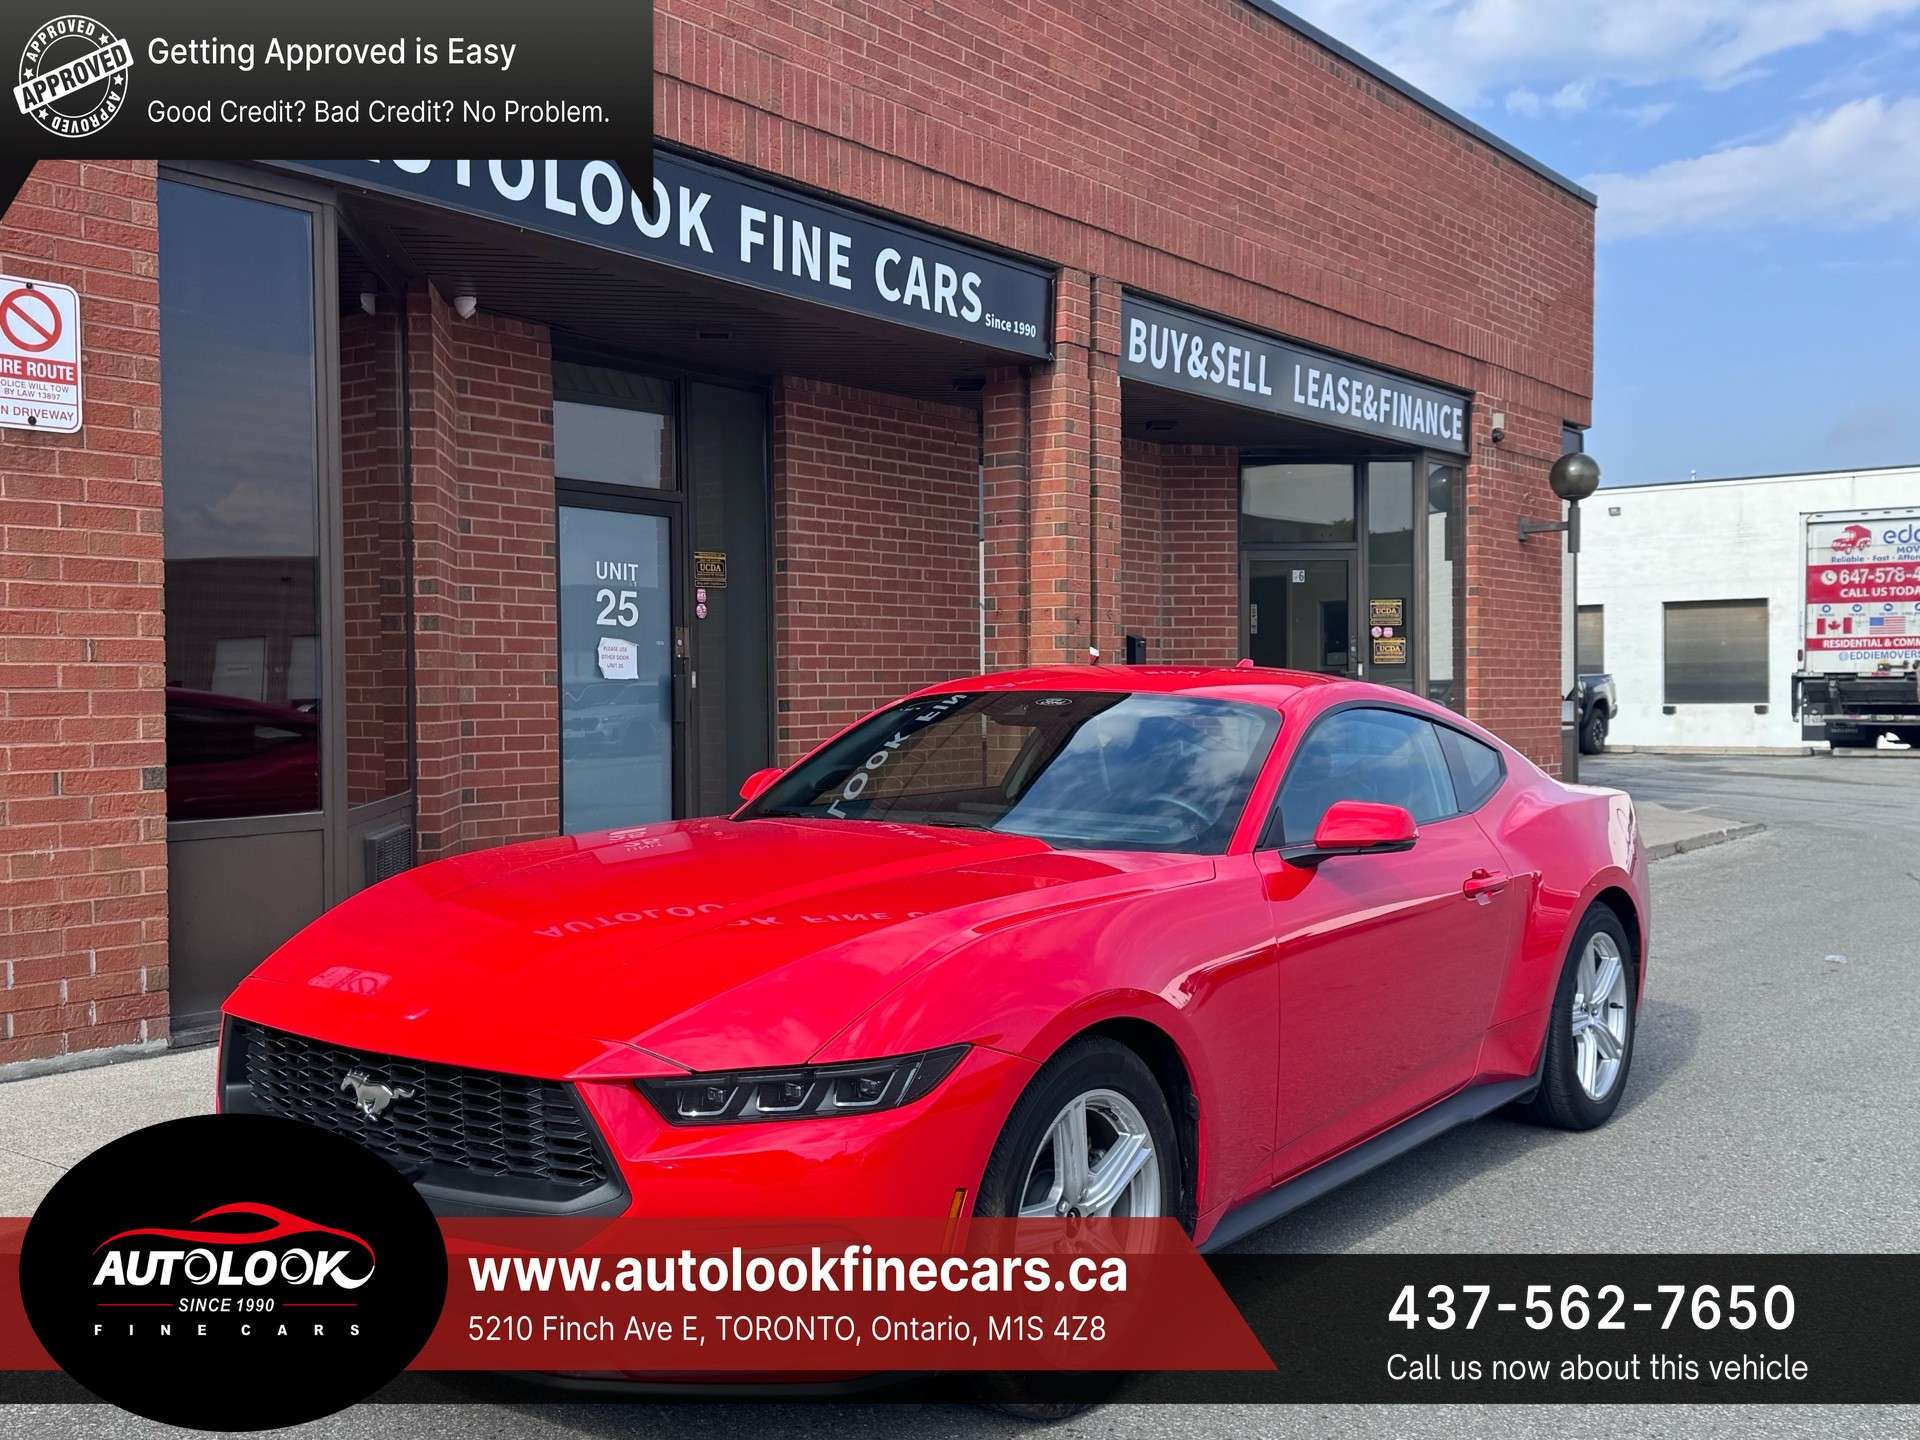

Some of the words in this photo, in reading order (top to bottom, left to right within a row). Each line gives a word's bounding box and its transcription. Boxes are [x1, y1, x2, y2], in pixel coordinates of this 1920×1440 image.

[741, 204, 851, 290] FINE
[875, 248, 982, 323] CARS
[985, 313, 1012, 332] Since
[1014, 320, 1037, 338] 1990
[26, 361, 75, 382] ROUTE
[1129, 318, 1272, 396] BUY&SELL
[1294, 364, 1463, 441] LEASE&FINANCE
[17, 390, 35, 398] LAW
[28, 382, 48, 391] WILL
[51, 384, 69, 393] TOW
[13, 406, 74, 421] DRIVEWAY
[1832, 555, 1865, 563] Reliable
[596, 560, 639, 582] UNIT
[700, 563, 721, 572] UCDA
[1840, 587, 1870, 597] CALL
[1872, 586, 1888, 596] US
[596, 588, 639, 627] 25
[1823, 638, 1883, 649] RESIDENTIAL
[1884, 638, 1892, 648] &
